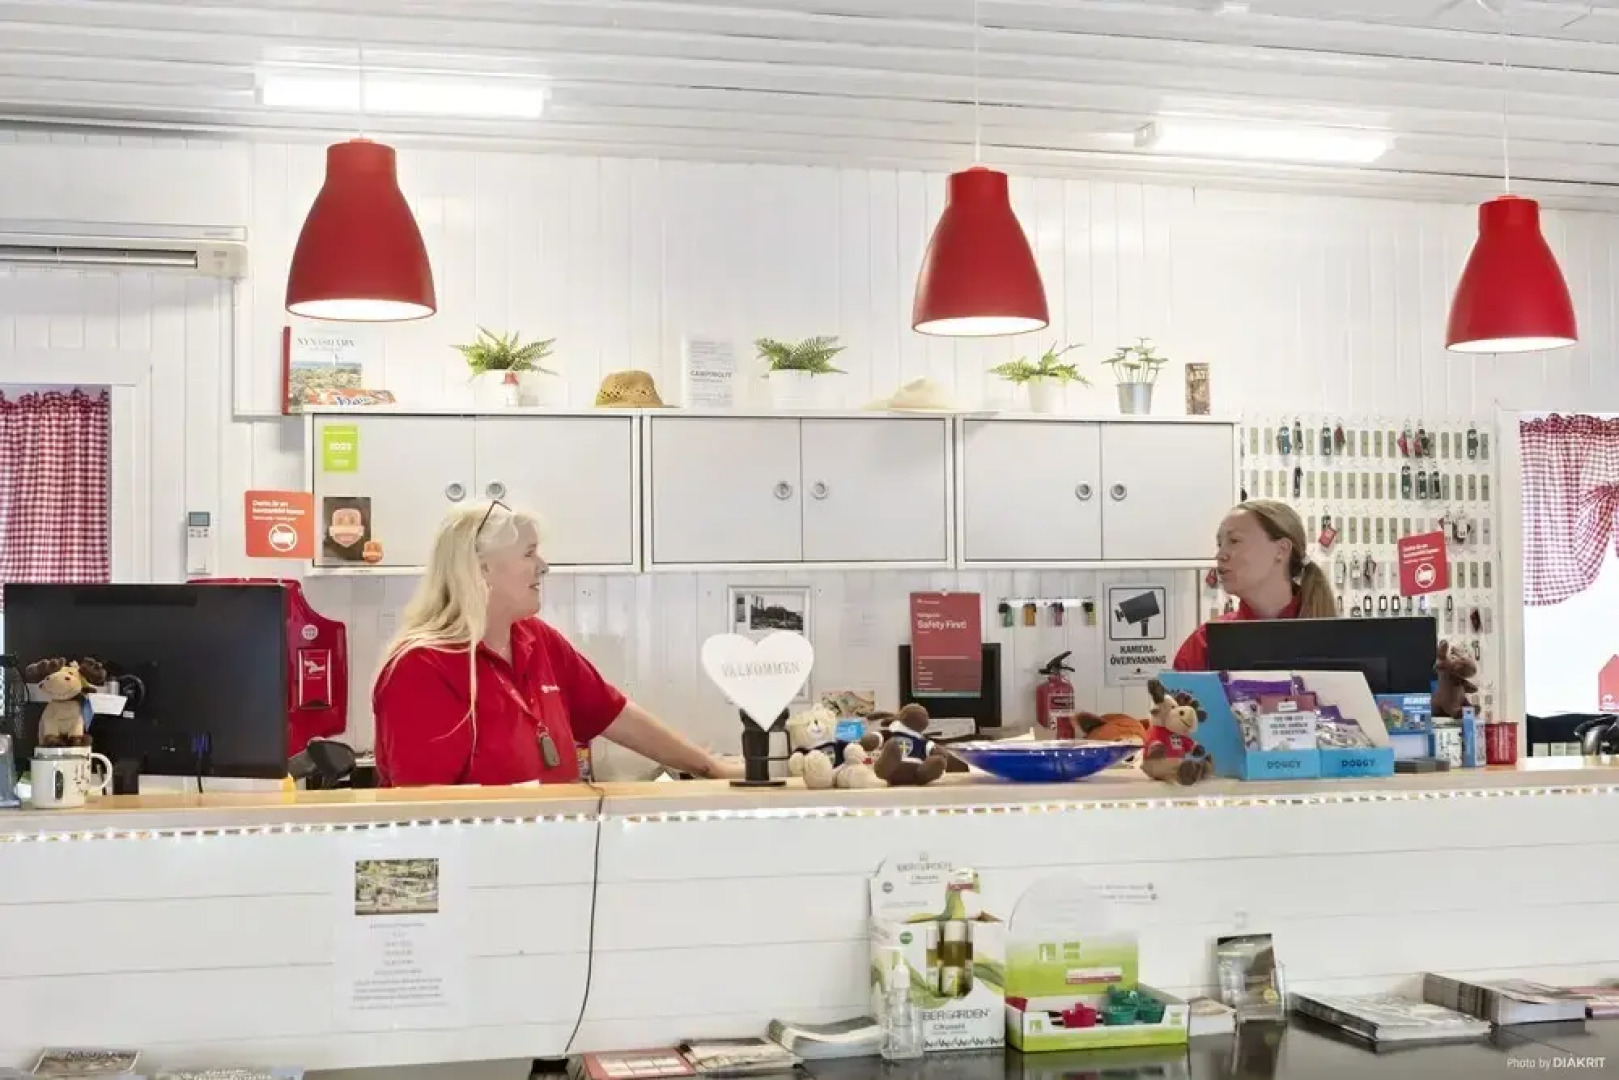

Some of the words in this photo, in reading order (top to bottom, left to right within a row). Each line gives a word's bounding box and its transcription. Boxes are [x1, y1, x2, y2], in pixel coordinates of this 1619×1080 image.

[917, 620, 944, 630] Safety
[1120, 645, 1156, 654] KAMERA-
[1110, 654, 1166, 665] ÖVERVAKNING
[1341, 759, 1375, 767] DOGGY
